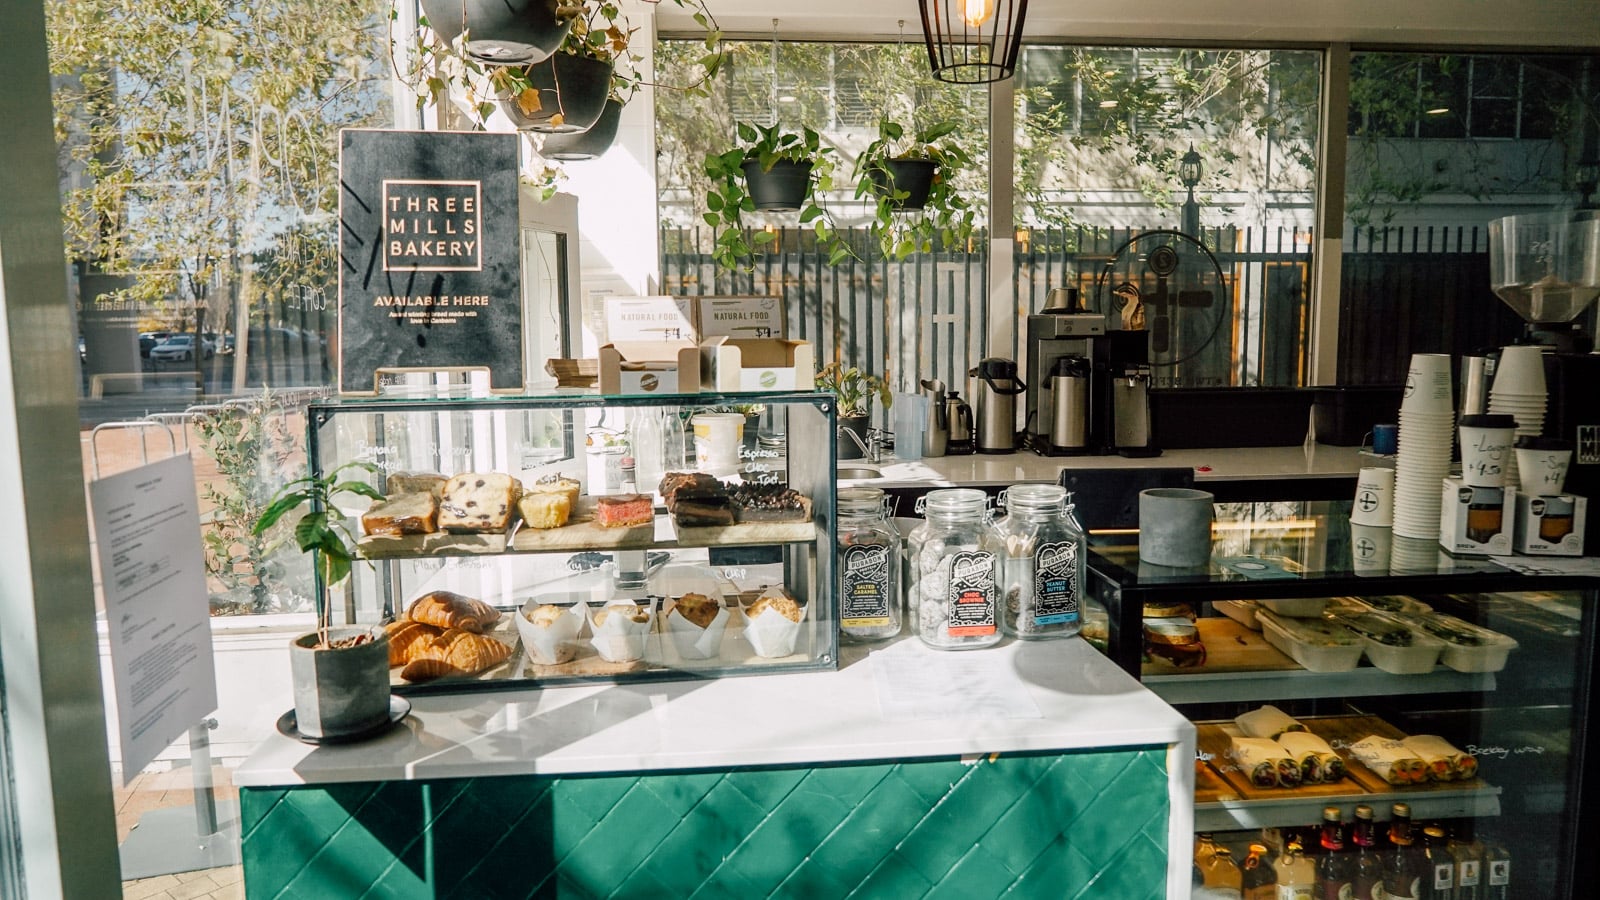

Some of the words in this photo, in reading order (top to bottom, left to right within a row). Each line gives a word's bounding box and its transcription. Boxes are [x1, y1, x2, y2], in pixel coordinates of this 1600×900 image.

[389, 197, 474, 212] THREE
[390, 219, 474, 234] MILLS
[390, 241, 476, 256] BAKERY
[374, 296, 449, 307] AVAILABLE
[453, 296, 489, 307] HERE
[621, 312, 656, 321] NATURAL
[658, 312, 679, 321] FOOD
[713, 312, 747, 321] NATURAL
[750, 312, 769, 320] FOOD
[738, 445, 779, 461] Espresso
[851, 556, 882, 569] PURABON
[1043, 552, 1071, 566] PURABON
[958, 563, 988, 575] PURABON
